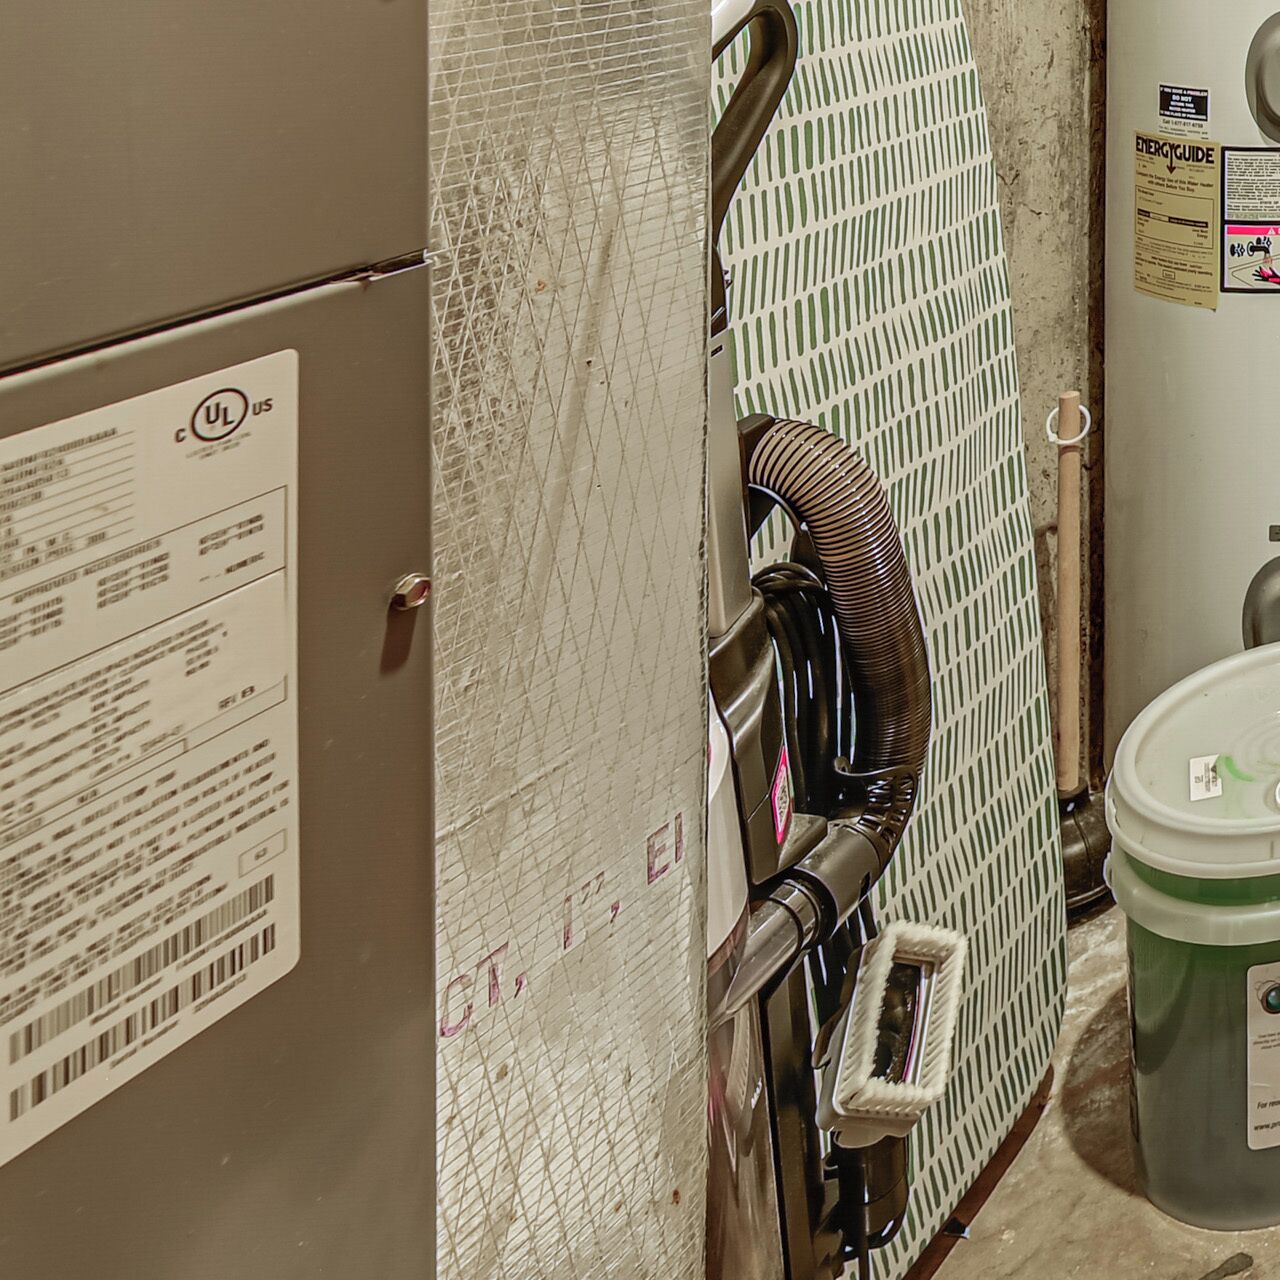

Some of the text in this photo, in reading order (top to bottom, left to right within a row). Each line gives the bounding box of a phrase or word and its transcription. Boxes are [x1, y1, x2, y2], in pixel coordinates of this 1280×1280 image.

[1136, 135, 1214, 164] ENERGYGUIDE
[206, 401, 234, 426] UL
[252, 398, 273, 415] US
[175, 428, 186, 443] C
[1257, 1100, 1268, 1109] For
